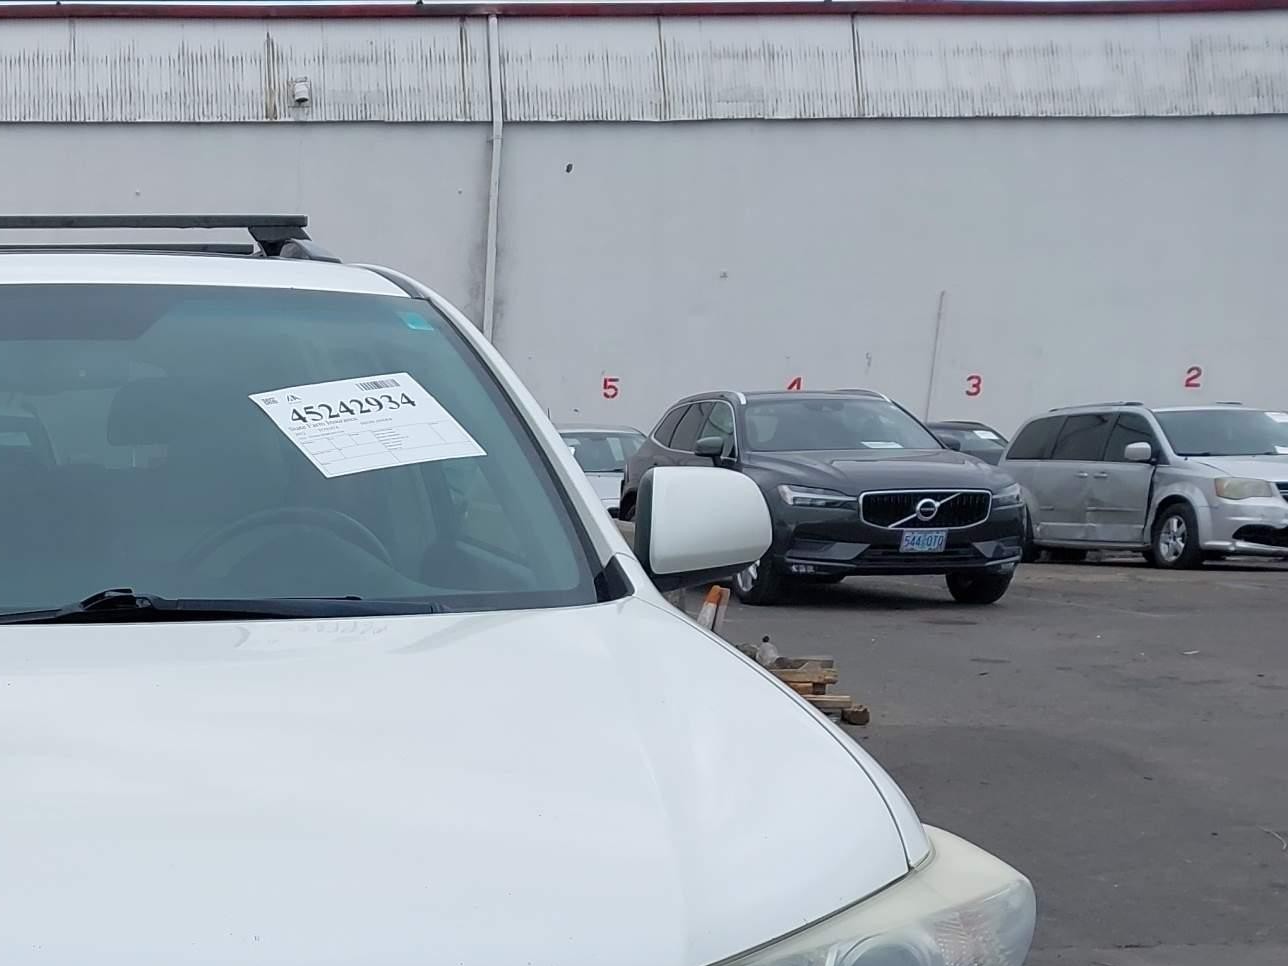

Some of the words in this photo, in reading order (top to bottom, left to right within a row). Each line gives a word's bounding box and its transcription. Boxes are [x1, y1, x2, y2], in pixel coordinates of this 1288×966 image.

[602, 376, 620, 399] 5
[965, 374, 982, 396] 3
[1184, 365, 1202, 388] 2
[291, 392, 416, 423] 45242934
